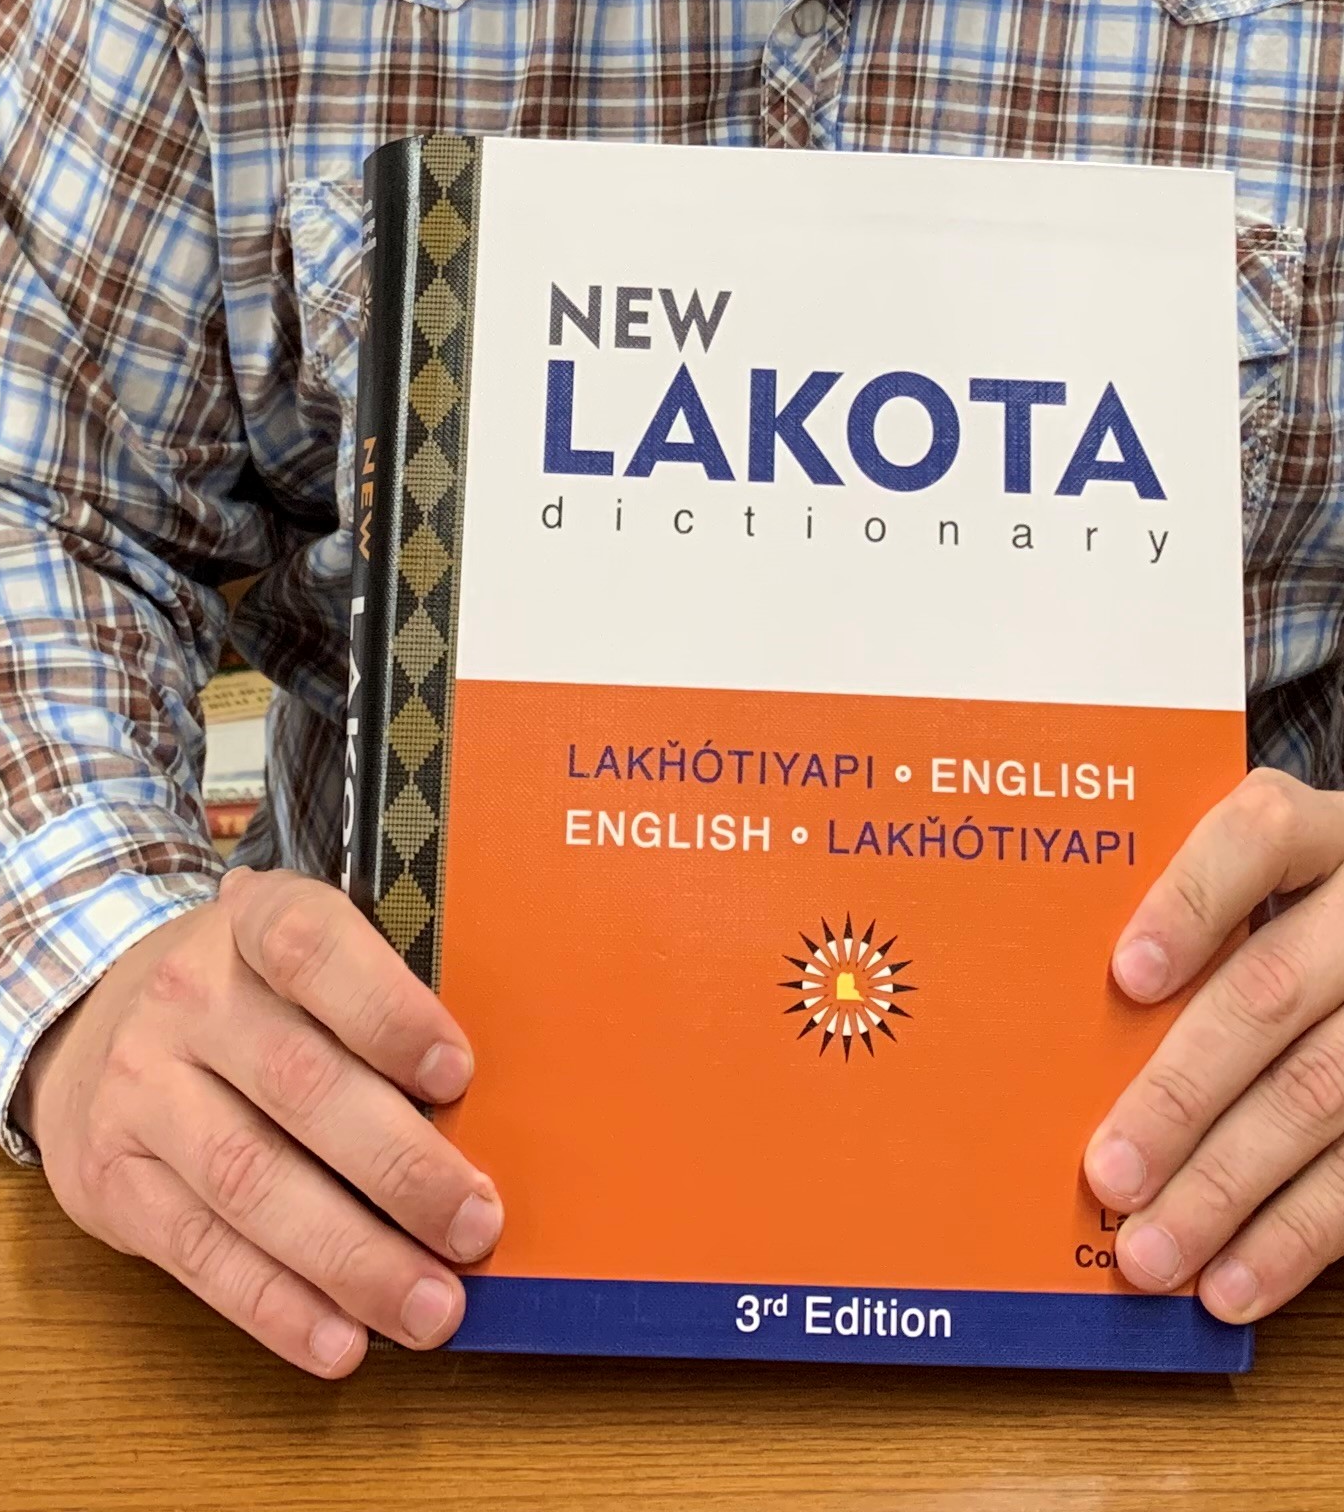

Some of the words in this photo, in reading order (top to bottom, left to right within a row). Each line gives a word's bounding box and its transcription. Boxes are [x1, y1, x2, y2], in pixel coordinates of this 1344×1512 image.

[548, 281, 733, 354] NEW
[542, 358, 1169, 502] LAKOTA
[358, 435, 378, 562] NEW
[541, 495, 1171, 564] dictionary
[567, 738, 877, 792] LAKȞÓTIYAPI
[930, 758, 1137, 802] ENGLISH
[564, 809, 772, 853] ENGLISH
[826, 814, 1137, 868] LAKȞÓTIYAPI
[734, 1294, 790, 1335] 3rd
[804, 1294, 954, 1338] Edition
